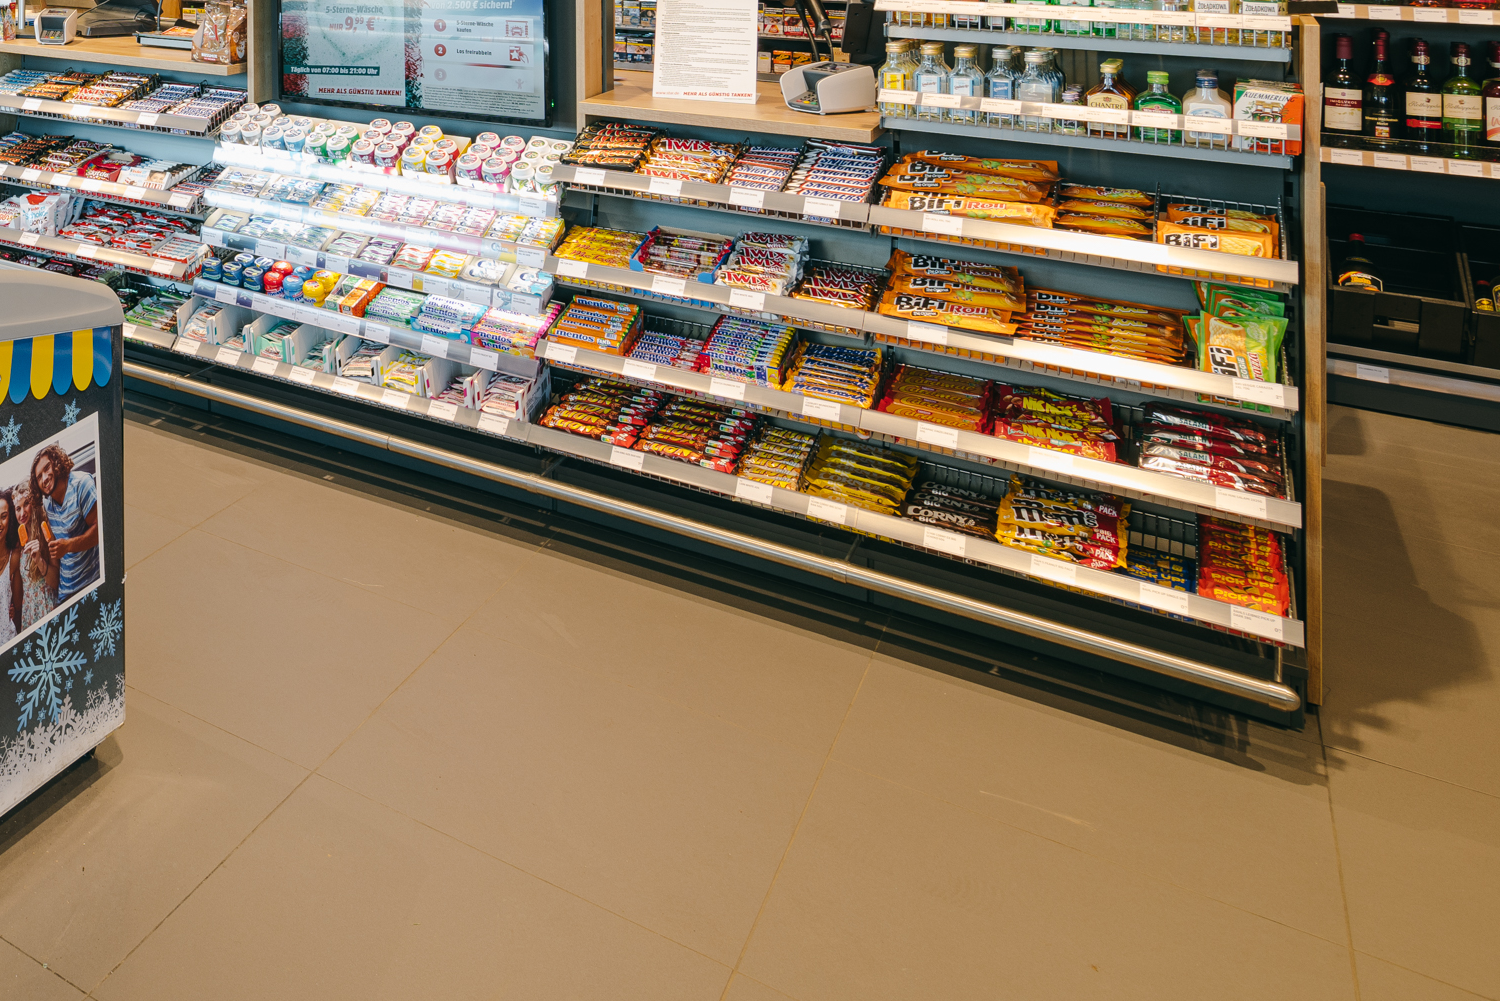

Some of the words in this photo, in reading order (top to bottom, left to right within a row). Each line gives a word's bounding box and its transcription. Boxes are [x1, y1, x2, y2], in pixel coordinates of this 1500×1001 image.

[326, 5, 383, 14] 5-Sterne-Wäsche
[447, 1, 471, 10] 2.500
[472, 1, 478, 9] €
[291, 66, 310, 74] Täglich
[348, 87, 374, 95] GÜNSTIG
[1243, 91, 1295, 103] KUEMMERLING
[1090, 100, 1124, 109] CHANTRÉ
[732, 180, 780, 191] SNICKERS
[803, 189, 862, 202] SNICKERS
[577, 298, 615, 310] mentos
[425, 305, 458, 319] mentos
[478, 331, 512, 345] mentos
[555, 329, 595, 343] mentos
[709, 352, 750, 365] mentos
[558, 419, 593, 433] LION
[652, 442, 693, 456] LION
[1179, 451, 1208, 461] SALAMI
[907, 505, 976, 526] CORNY
[918, 516, 936, 524] BIG
[1096, 533, 1116, 544] PACK
